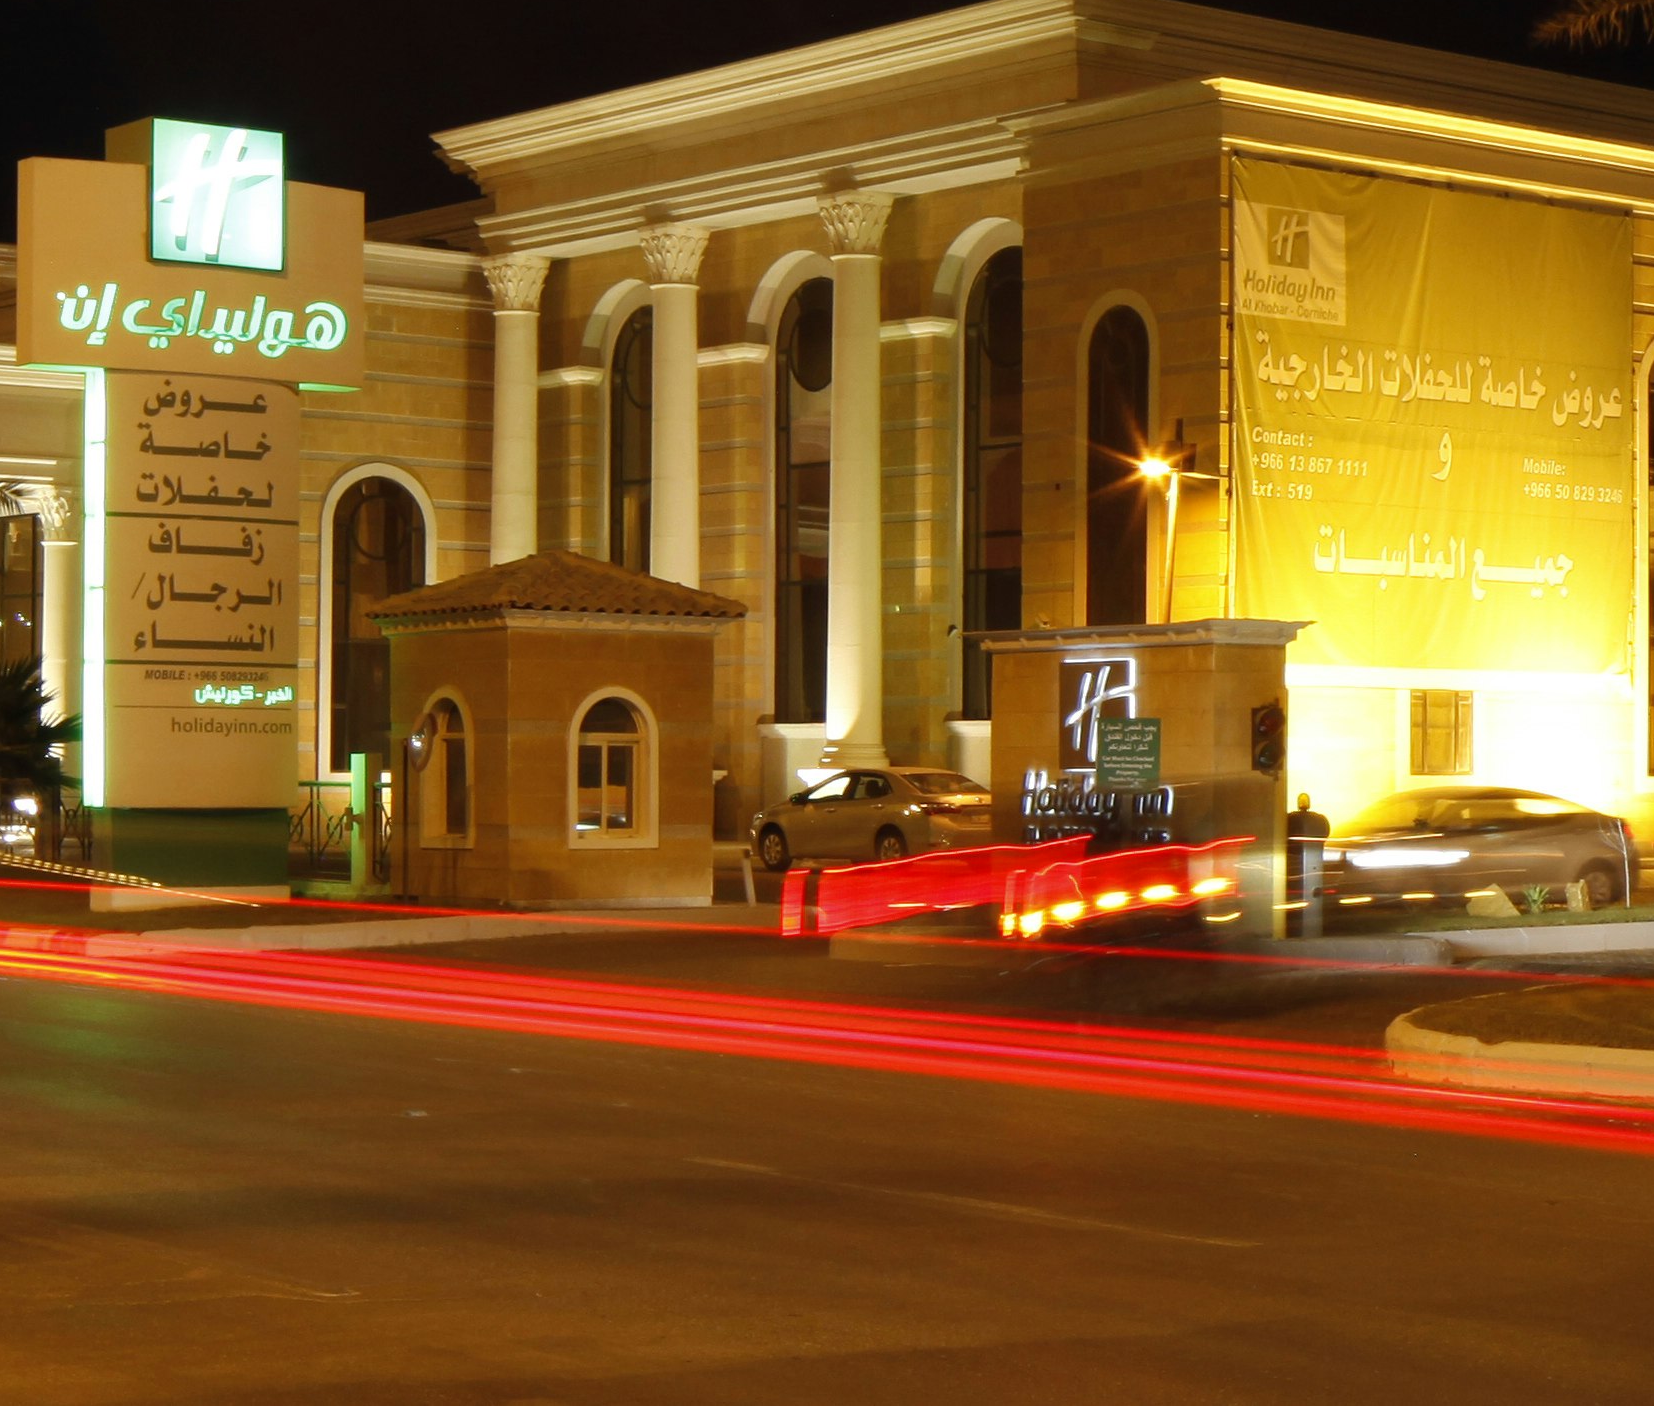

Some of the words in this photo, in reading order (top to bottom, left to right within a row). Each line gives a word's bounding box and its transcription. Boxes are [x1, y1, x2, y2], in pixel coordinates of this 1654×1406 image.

[1244, 269, 1308, 303] Holiday
[1310, 278, 1336, 301] Inn
[55, 282, 118, 346] إن
[122, 289, 347, 358] هوليداي
[1242, 298, 1252, 310] Al
[1254, 300, 1288, 315] Khobar
[1297, 305, 1339, 322] Corniche
[1256, 330, 1374, 401] الخارجية
[1380, 349, 1473, 403] للحفلات
[1478, 356, 1546, 409] خاصة
[143, 379, 268, 418] عروض
[1552, 371, 1622, 429] عروض
[137, 422, 272, 461] خاصة
[1252, 426, 1304, 447] Contact
[1251, 452, 1283, 470] +966
[1289, 455, 1305, 472] 13
[1308, 457, 1333, 474] 867
[1337, 459, 1368, 476] 1111
[1430, 432, 1453, 481] و
[1523, 457, 1566, 475] Mobile:
[136, 471, 274, 508] لحفلات
[1251, 479, 1273, 497] Ext
[1288, 483, 1313, 500] 519
[1523, 482, 1552, 498] +966
[1554, 484, 1570, 500] 50
[1573, 485, 1595, 501] 829
[1597, 487, 1623, 504] 3246
[148, 522, 265, 566] زفاف
[1313, 524, 1466, 591] المناسبات
[1471, 548, 1574, 601] جميع
[134, 620, 275, 652] النساء
[144, 669, 186, 681] MOBILE
[194, 671, 217, 681] +966
[194, 683, 254, 705] كورنيش
[264, 685, 293, 706] الخبر
[171, 717, 292, 737] holidayinn.com
